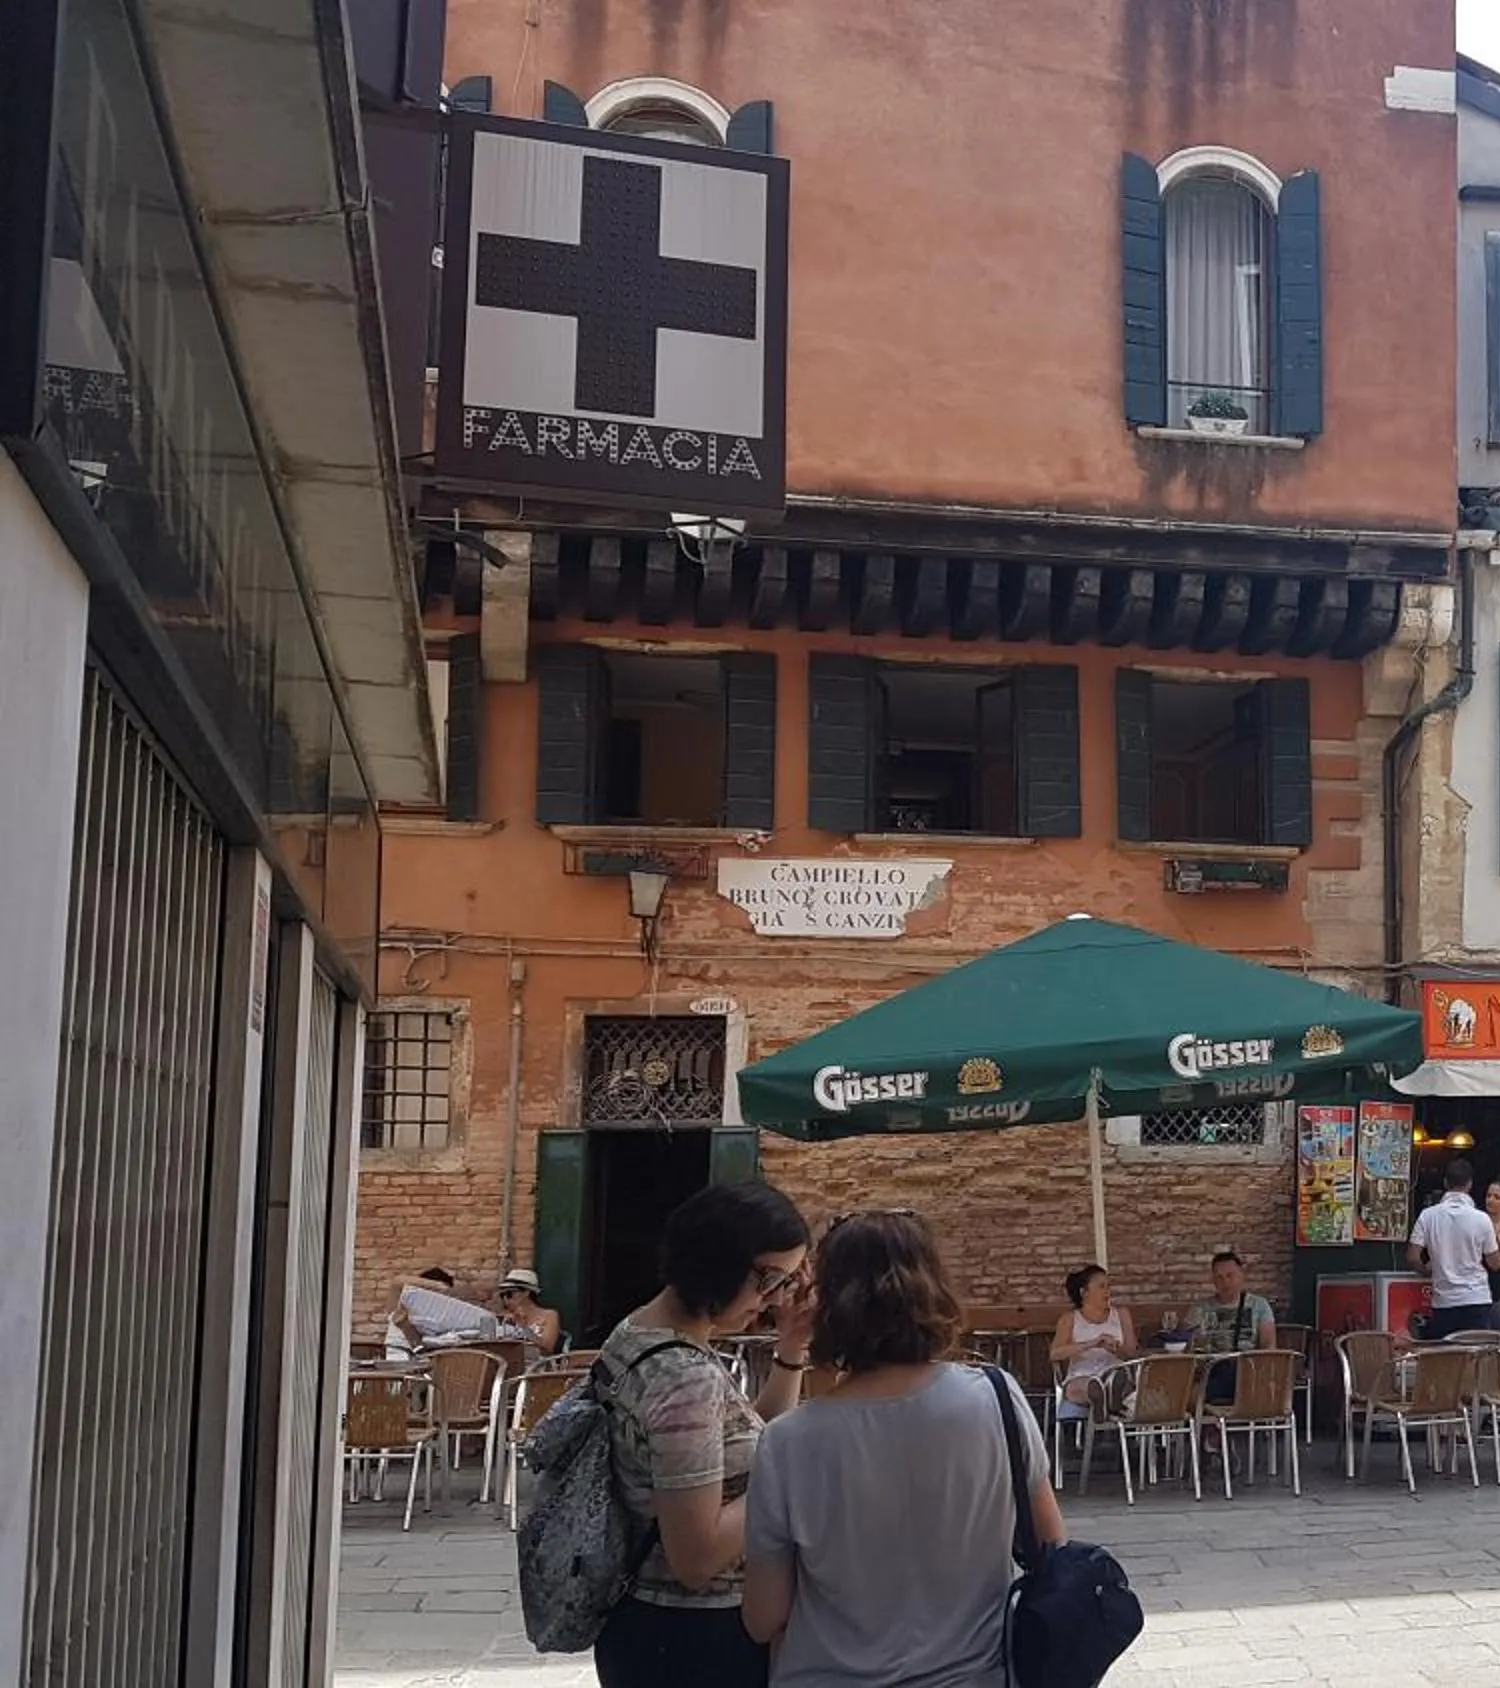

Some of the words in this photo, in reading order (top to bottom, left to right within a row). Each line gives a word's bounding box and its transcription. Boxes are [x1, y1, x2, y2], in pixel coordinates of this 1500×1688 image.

[462, 407, 763, 481] FARMACIA
[730, 888, 812, 905] BRUNO
[770, 865, 906, 885] CAMPIELLO
[1168, 1033, 1275, 1079] Gösser
[813, 1064, 930, 1111] Gösser
